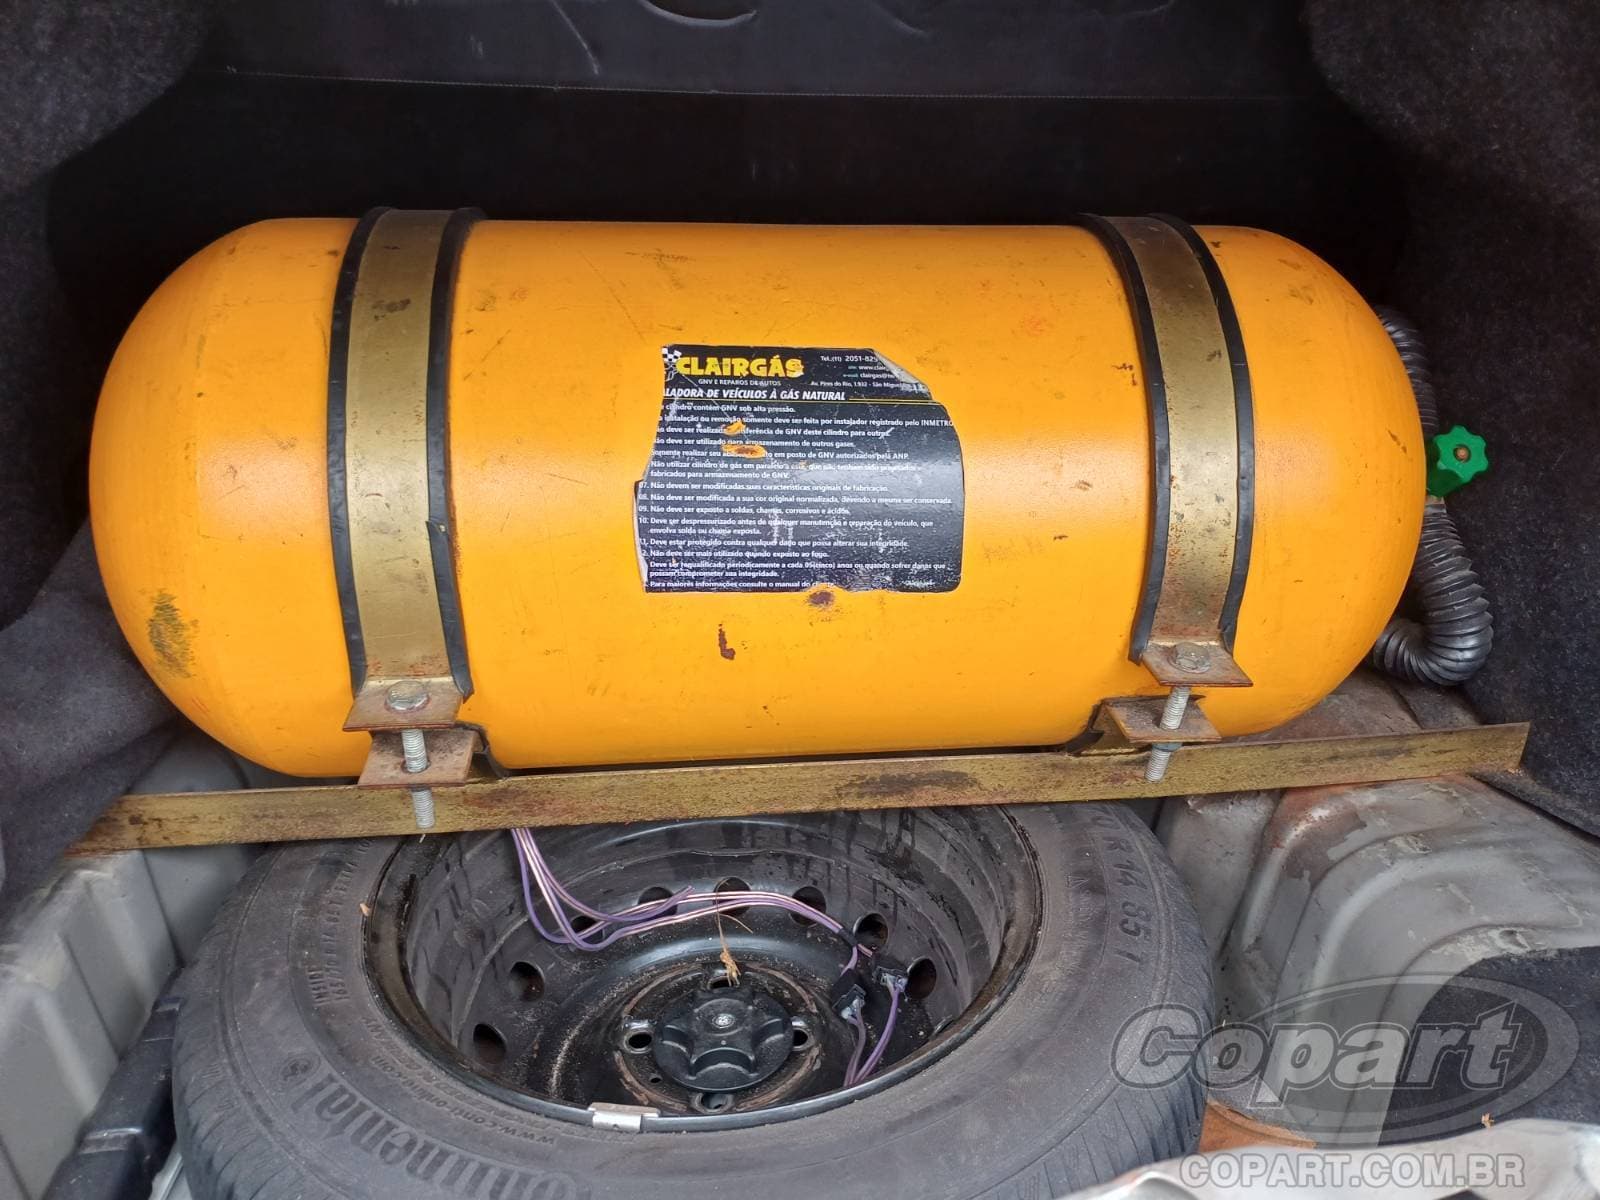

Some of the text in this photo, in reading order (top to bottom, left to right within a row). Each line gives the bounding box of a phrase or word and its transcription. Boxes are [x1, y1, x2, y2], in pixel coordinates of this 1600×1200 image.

[675, 355, 804, 378] CLAIRGÁS
[664, 387, 846, 400] LADORA DE VEÍCULOS À GÁS NATURAL
[768, 495, 794, 503] original
